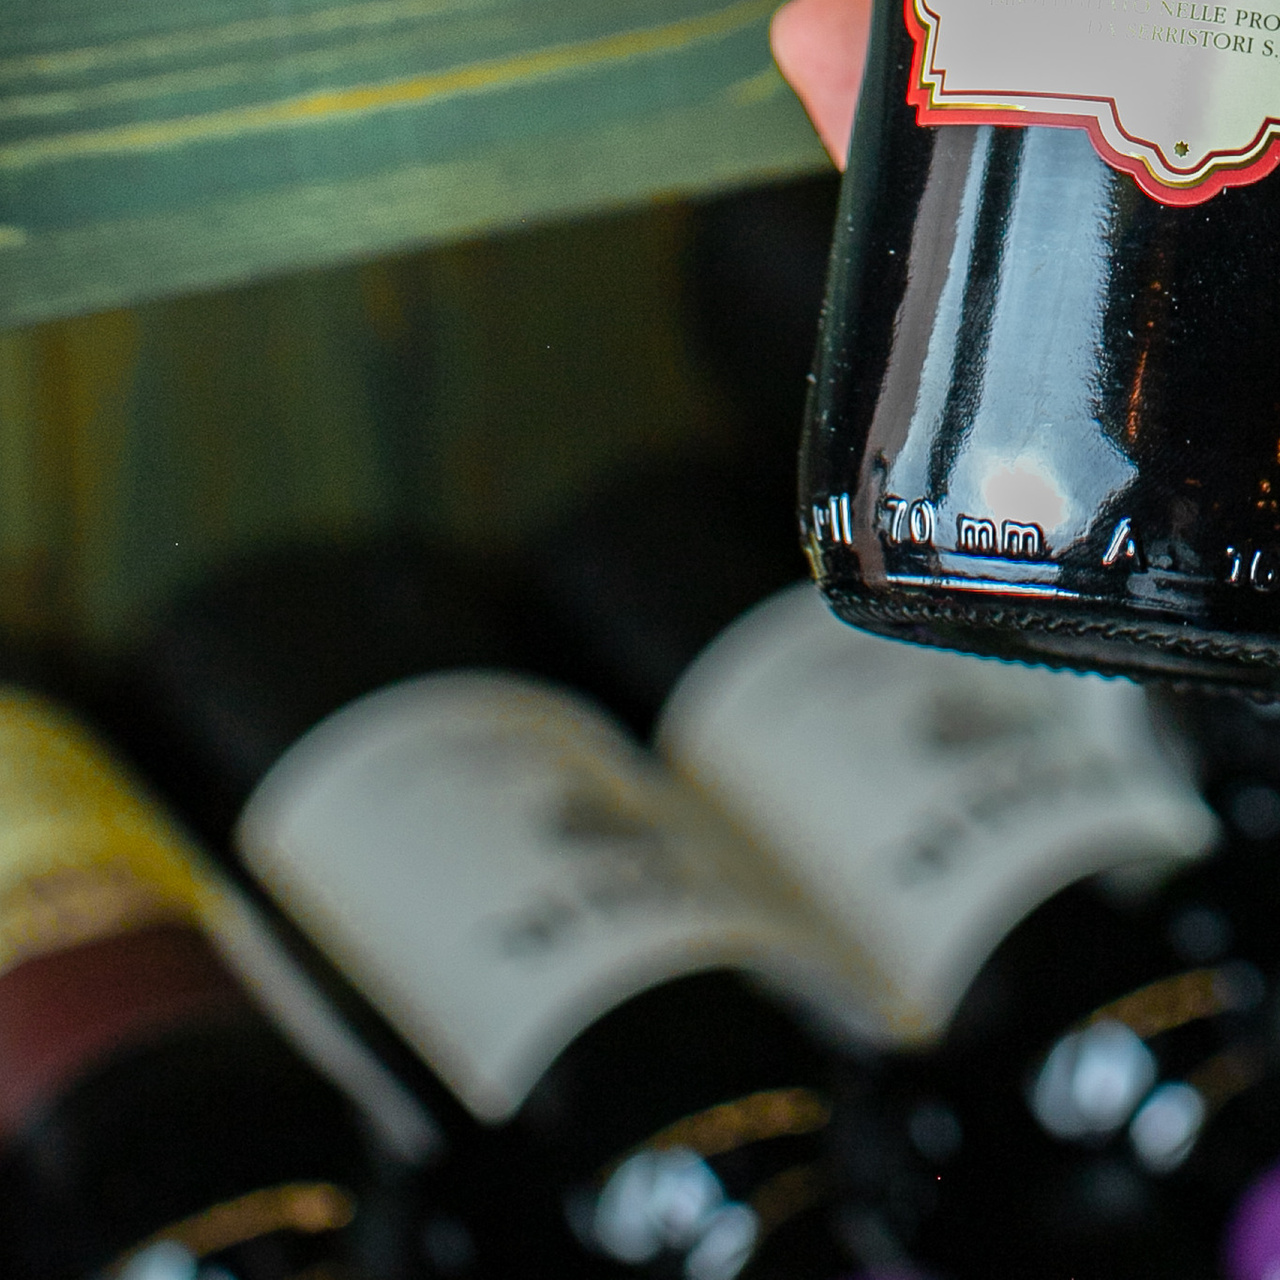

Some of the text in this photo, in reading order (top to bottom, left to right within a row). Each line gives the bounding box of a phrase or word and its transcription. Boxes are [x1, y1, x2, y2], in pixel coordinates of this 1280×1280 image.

[1160, 0, 1227, 26] NELLE
[1126, 22, 1255, 55] SERRISTORI
[884, 496, 936, 545] 70
[958, 514, 1044, 557] mm
